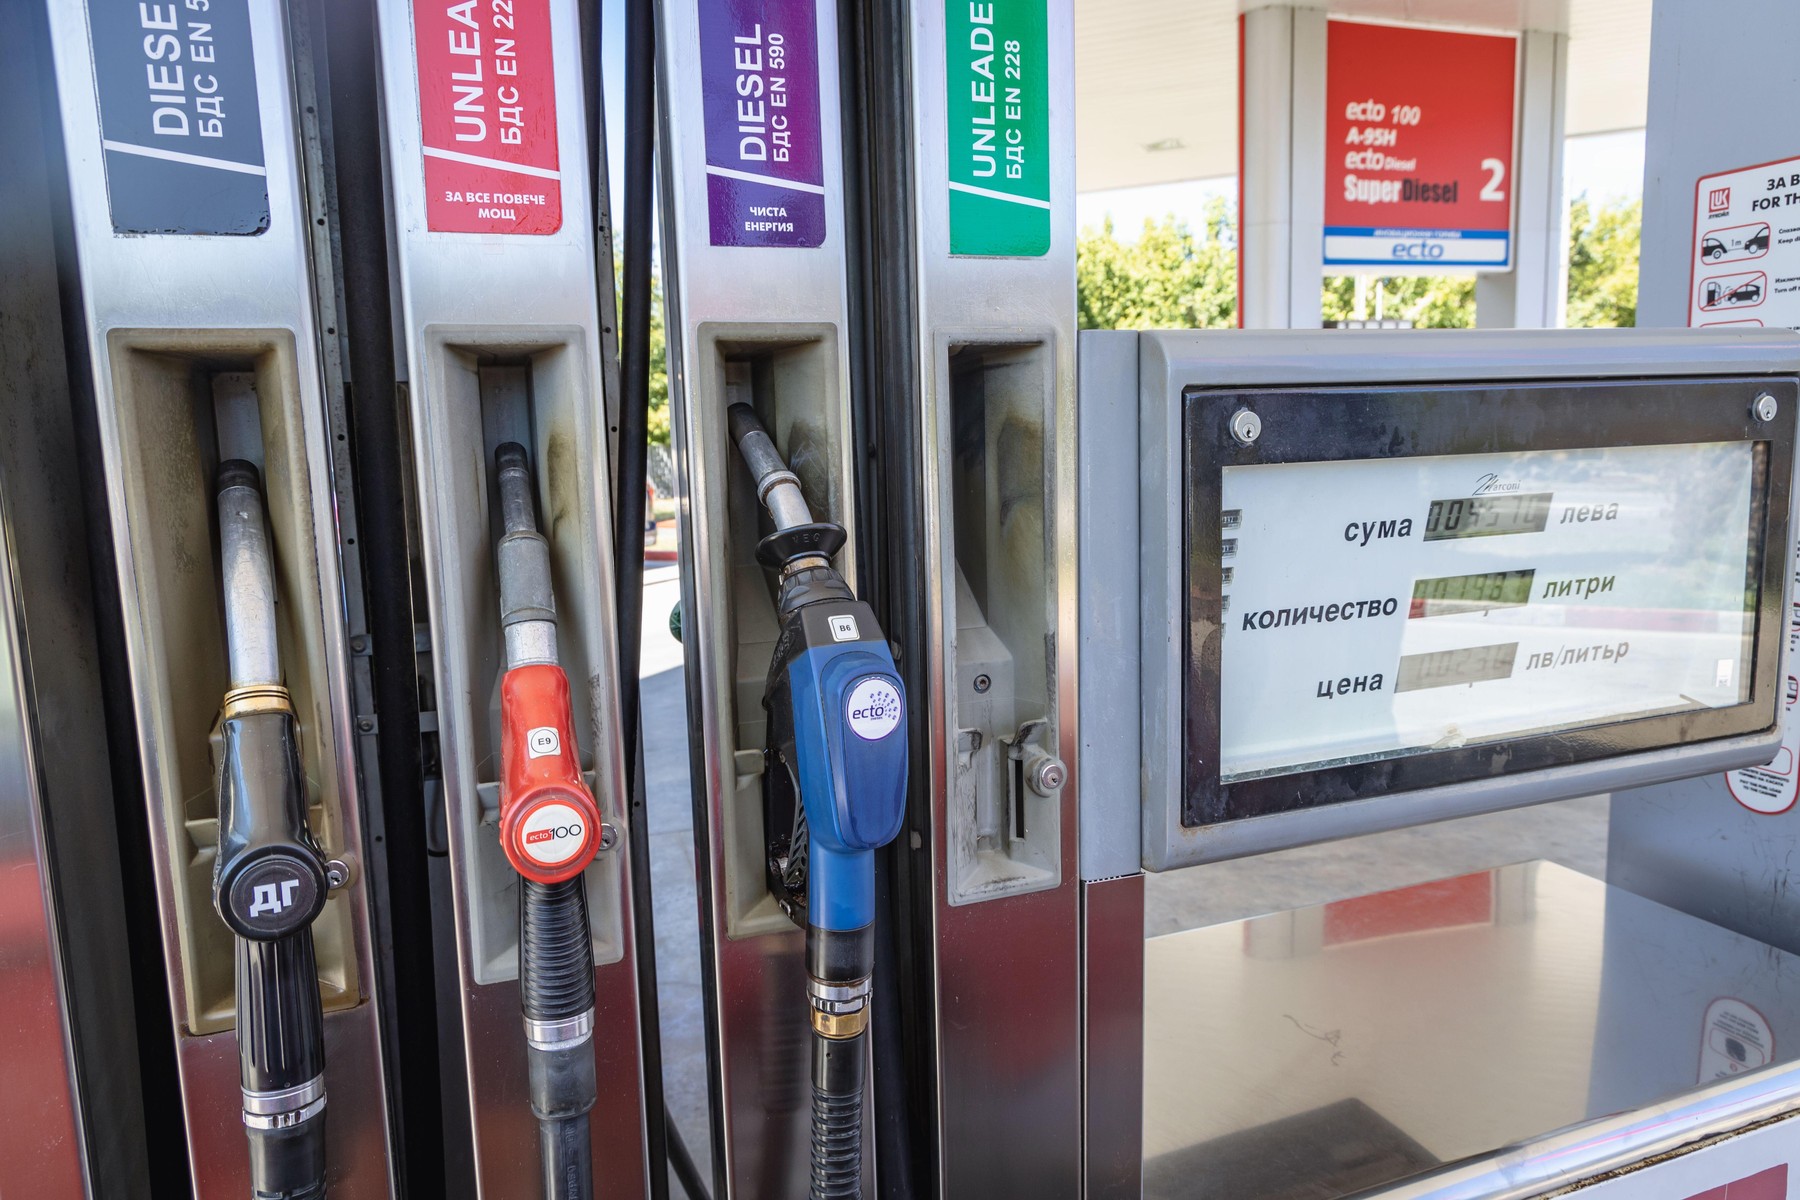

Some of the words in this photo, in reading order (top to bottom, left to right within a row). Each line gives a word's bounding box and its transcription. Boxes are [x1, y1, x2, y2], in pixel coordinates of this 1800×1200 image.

[187, 22, 215, 62] EN
[494, 38, 517, 76] EN
[768, 33, 785, 70] 590
[1004, 40, 1021, 80] 228
[139, 2, 190, 136] DIESE
[447, 0, 487, 142] UNLEA
[193, 74, 226, 137] БДС
[734, 23, 767, 161] DIESEL
[770, 77, 787, 107] EN
[969, 2, 997, 177] UNLEADE
[1005, 88, 1021, 120] EN
[497, 86, 524, 145] БДС
[1345, 99, 1386, 121] ecto
[1391, 105, 1421, 126] 100
[771, 115, 791, 162] БДС
[1005, 129, 1025, 179] БДС
[445, 191, 463, 202] ЗА
[466, 192, 490, 203] ВСЕ
[494, 193, 545, 205] ПОВЕЧЕ
[1479, 157, 1506, 202] 2
[478, 208, 516, 220] МОЩ
[750, 206, 787, 217] ЧИСТА
[1752, 196, 1781, 212] FOR
[745, 222, 794, 232] ЕНЕРГИЯ
[1392, 239, 1445, 260] ecto
[1344, 518, 1413, 547] сума
[1560, 502, 1620, 524] лева
[1242, 598, 1398, 631] количество
[1542, 575, 1616, 600] литри
[1316, 673, 1384, 700] цена
[852, 704, 884, 720] ecto
[537, 737, 552, 747] E9
[249, 879, 300, 918] ДГ
